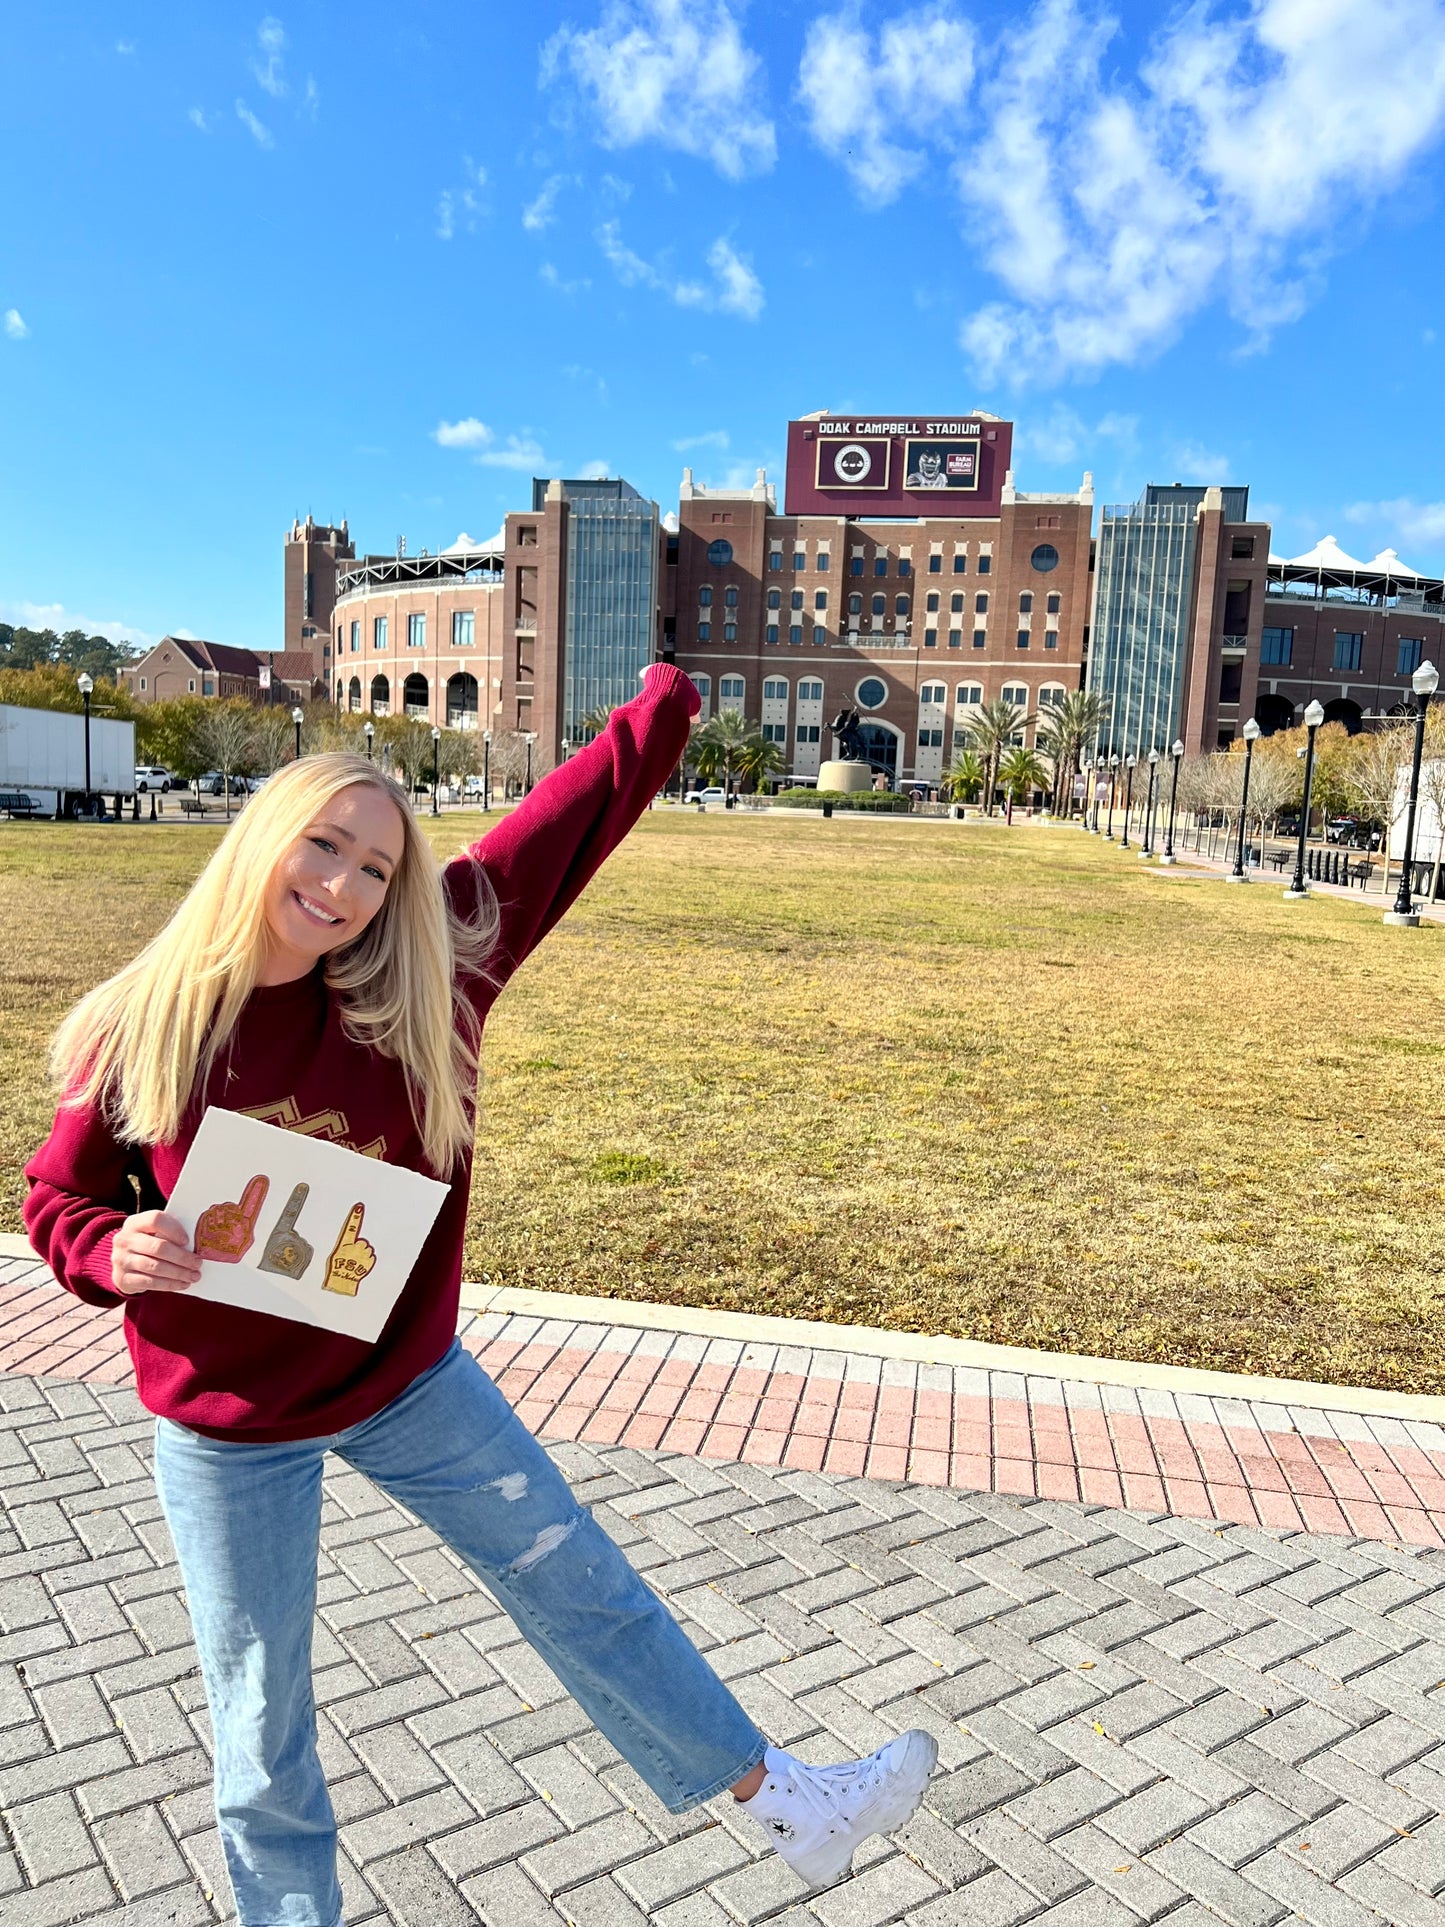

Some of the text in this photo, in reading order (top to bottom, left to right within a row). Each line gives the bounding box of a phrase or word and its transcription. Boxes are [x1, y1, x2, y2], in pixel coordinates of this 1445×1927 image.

[819, 423, 981, 435] DOAK CAMPBELL STADIUM
[334, 1257, 367, 1276] FSU
